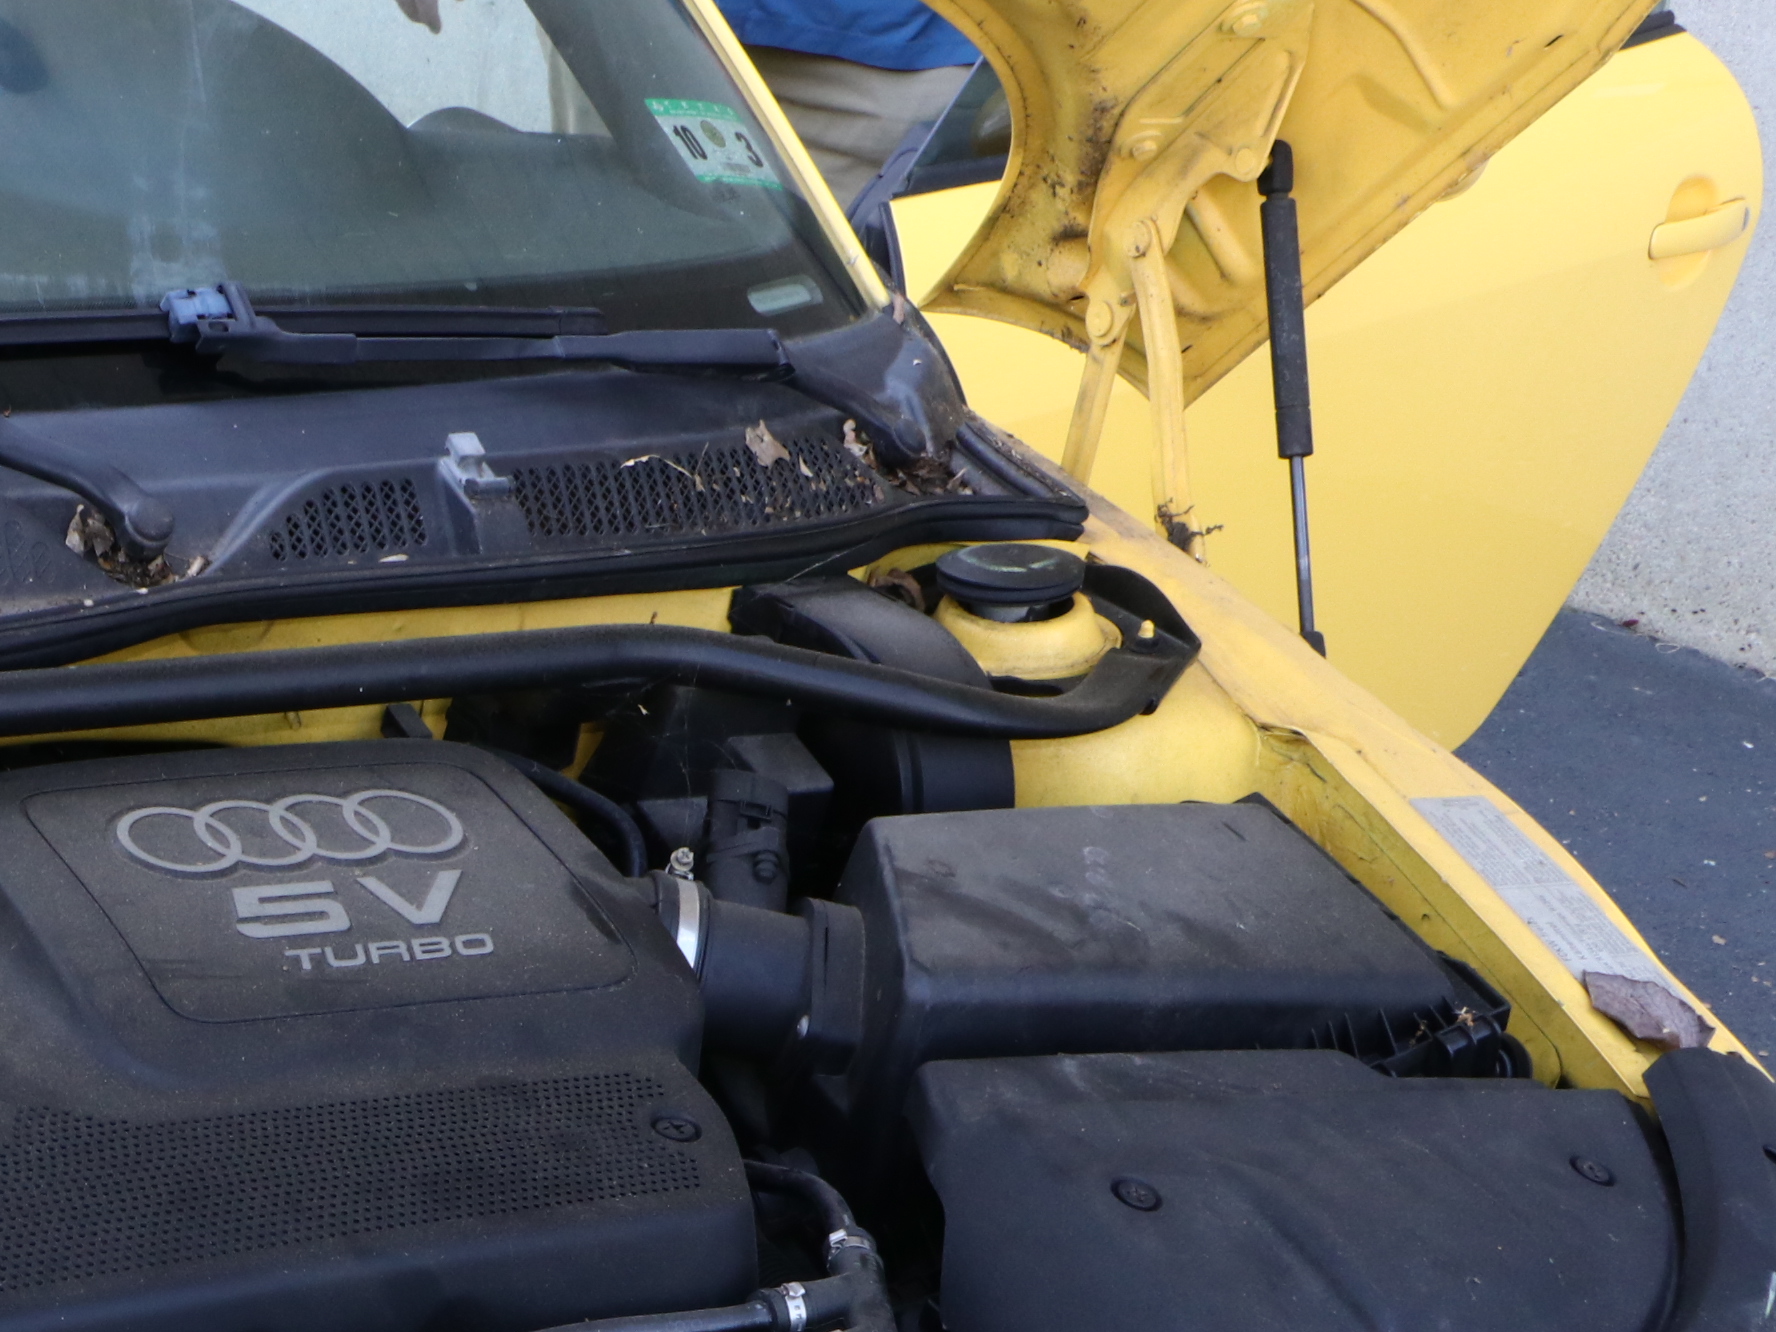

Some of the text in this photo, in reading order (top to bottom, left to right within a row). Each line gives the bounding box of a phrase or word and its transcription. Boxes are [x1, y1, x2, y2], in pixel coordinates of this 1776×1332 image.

[673, 124, 708, 161] 10
[734, 131, 764, 168] 3
[231, 868, 463, 939] 5V
[284, 932, 495, 971] TURBO
